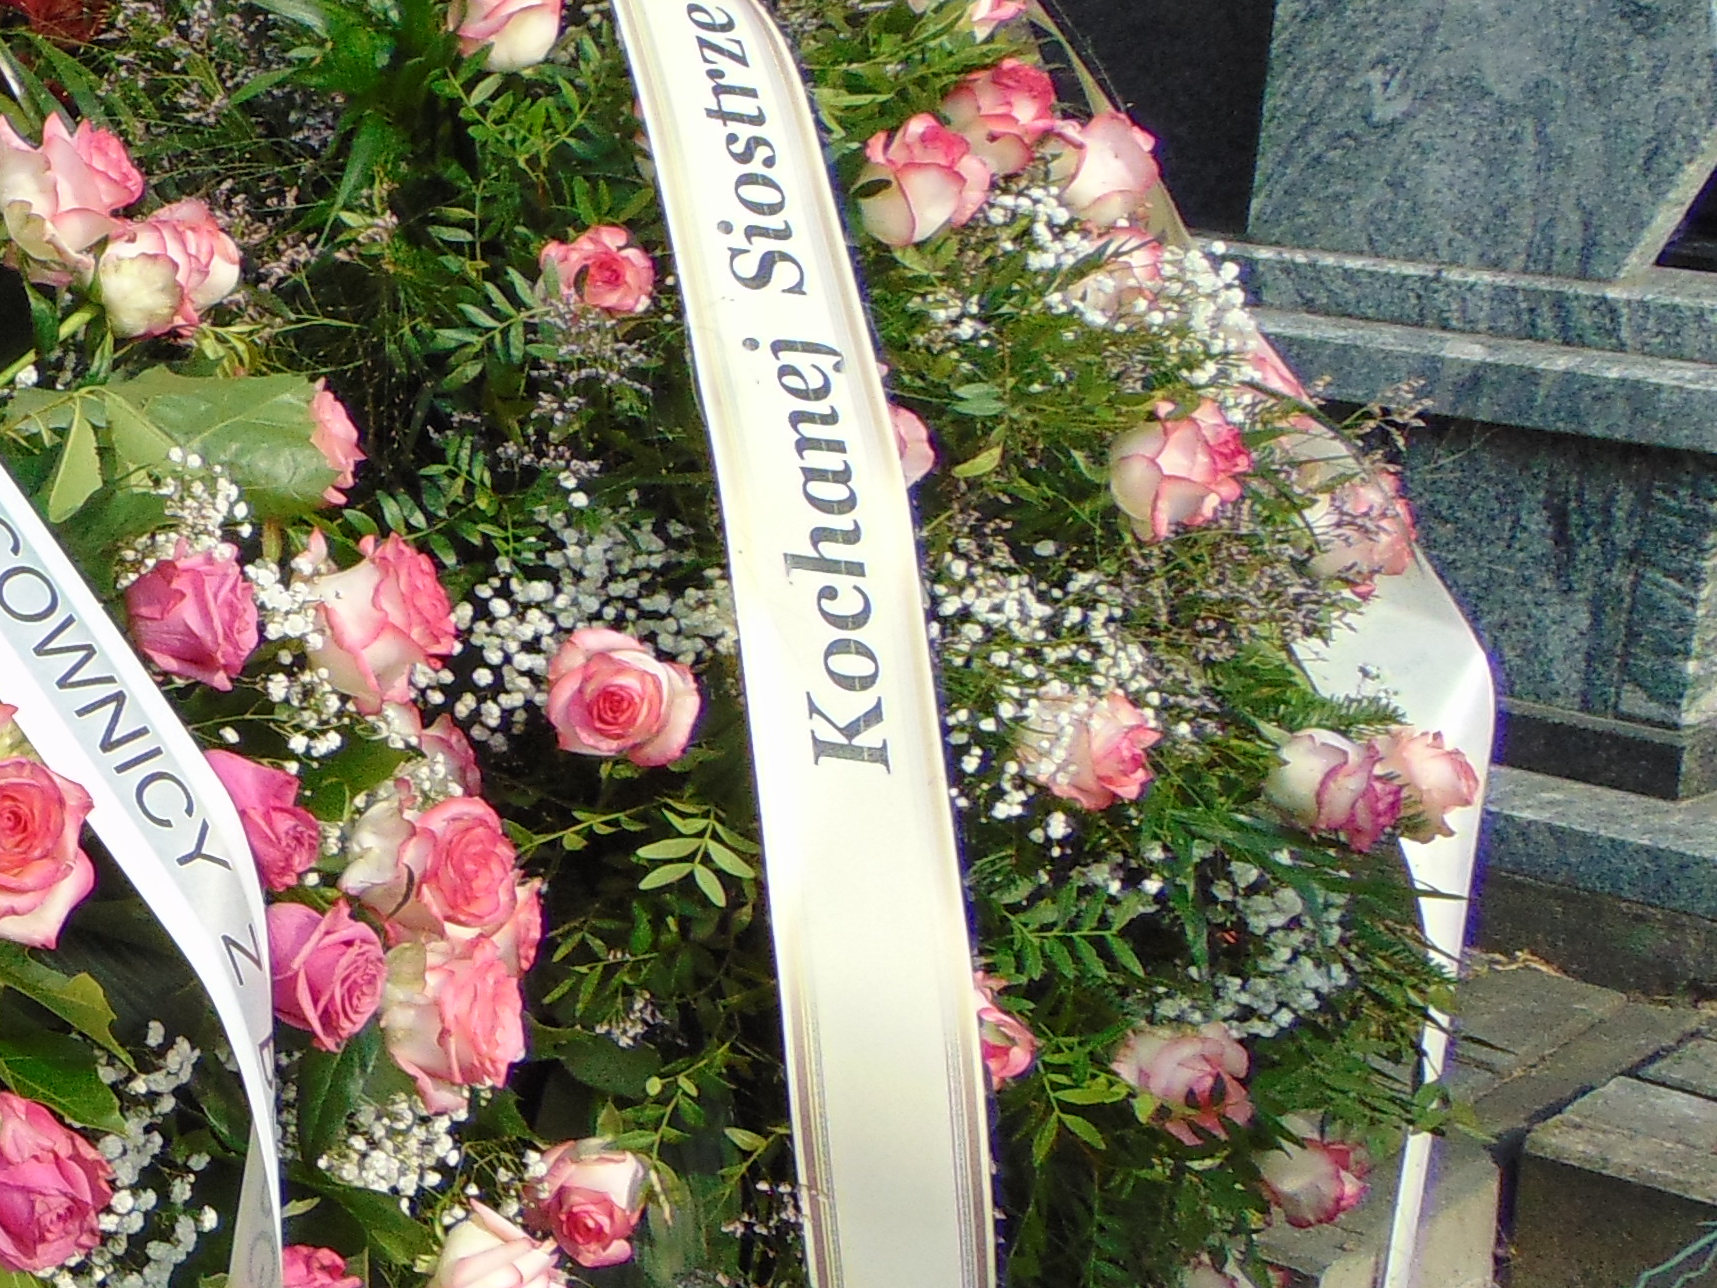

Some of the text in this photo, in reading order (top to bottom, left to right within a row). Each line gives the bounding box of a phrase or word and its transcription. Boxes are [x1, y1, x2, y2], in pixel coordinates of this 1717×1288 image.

[685, 2, 892, 775] Kochanej Siostrze
[220, 922, 264, 987] Z
